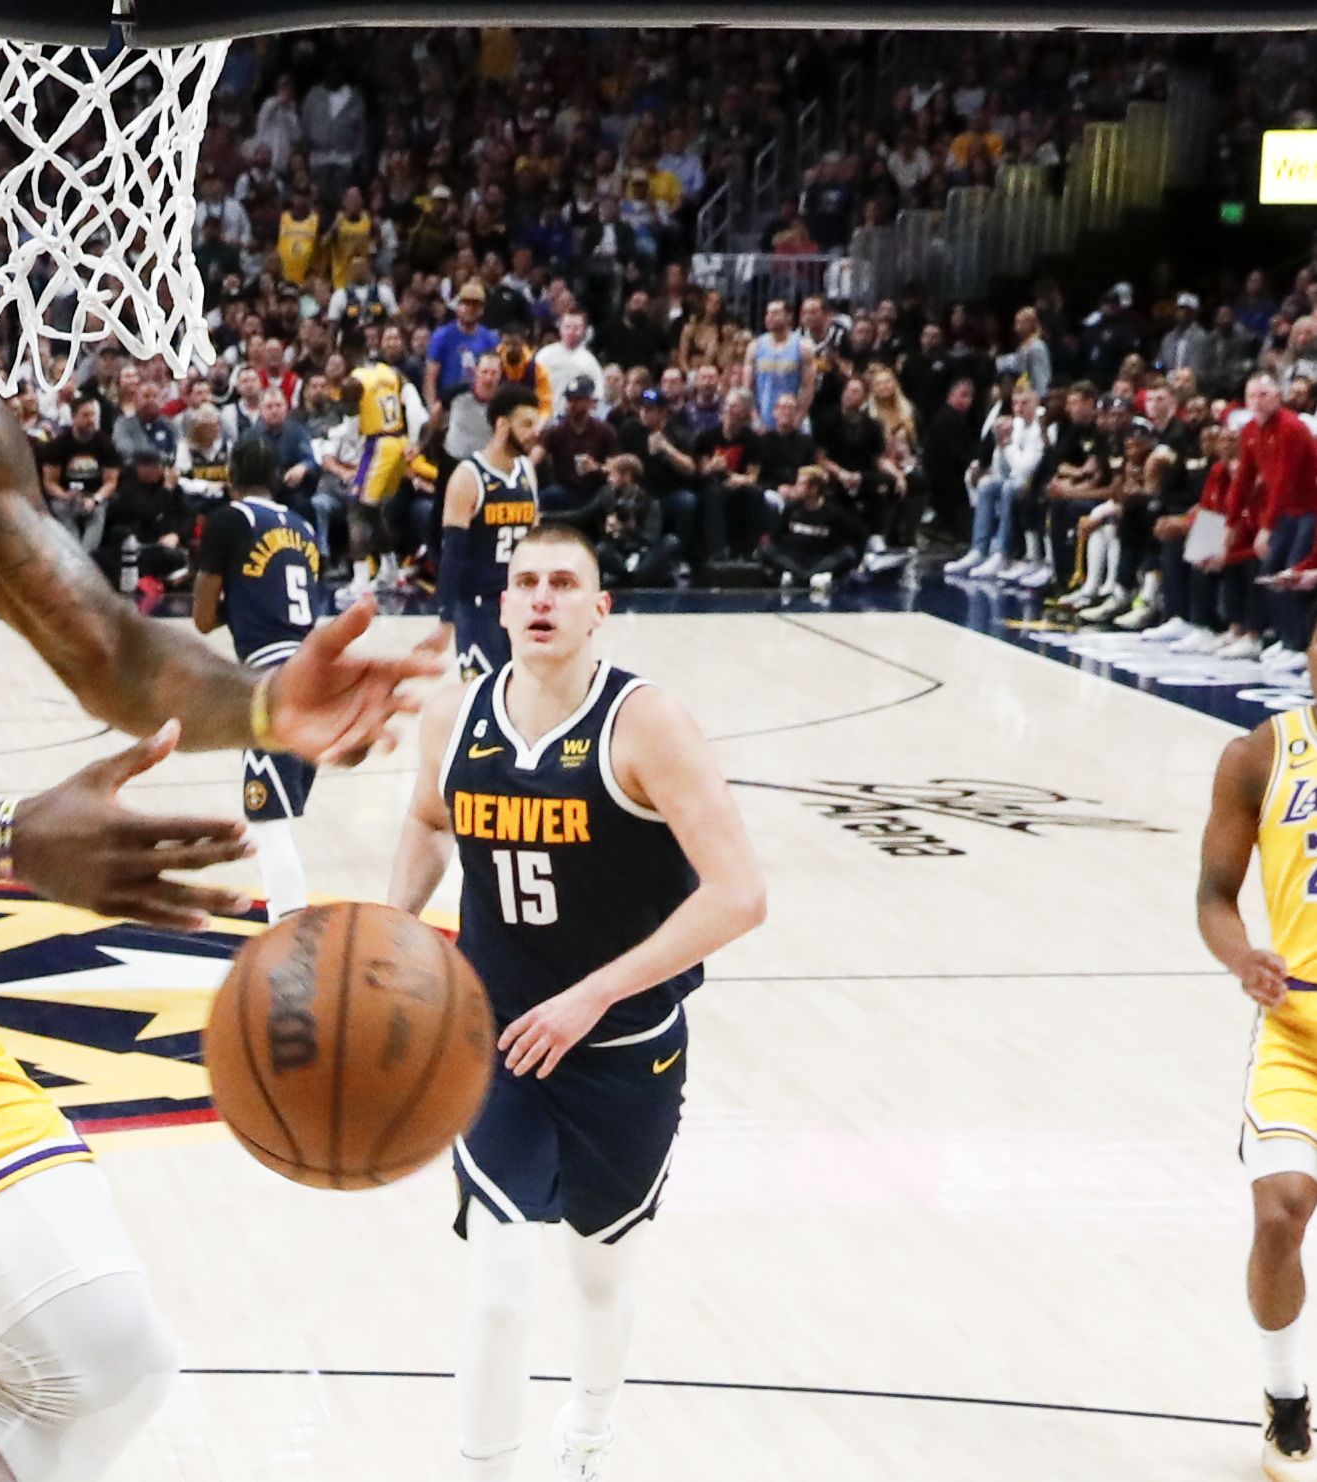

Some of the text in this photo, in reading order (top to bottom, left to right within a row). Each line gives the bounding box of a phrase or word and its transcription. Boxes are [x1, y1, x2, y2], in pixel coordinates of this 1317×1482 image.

[285, 565, 312, 626] 5
[563, 738, 591, 754] WU
[454, 790, 590, 844] DENVER
[492, 850, 558, 925] 15
